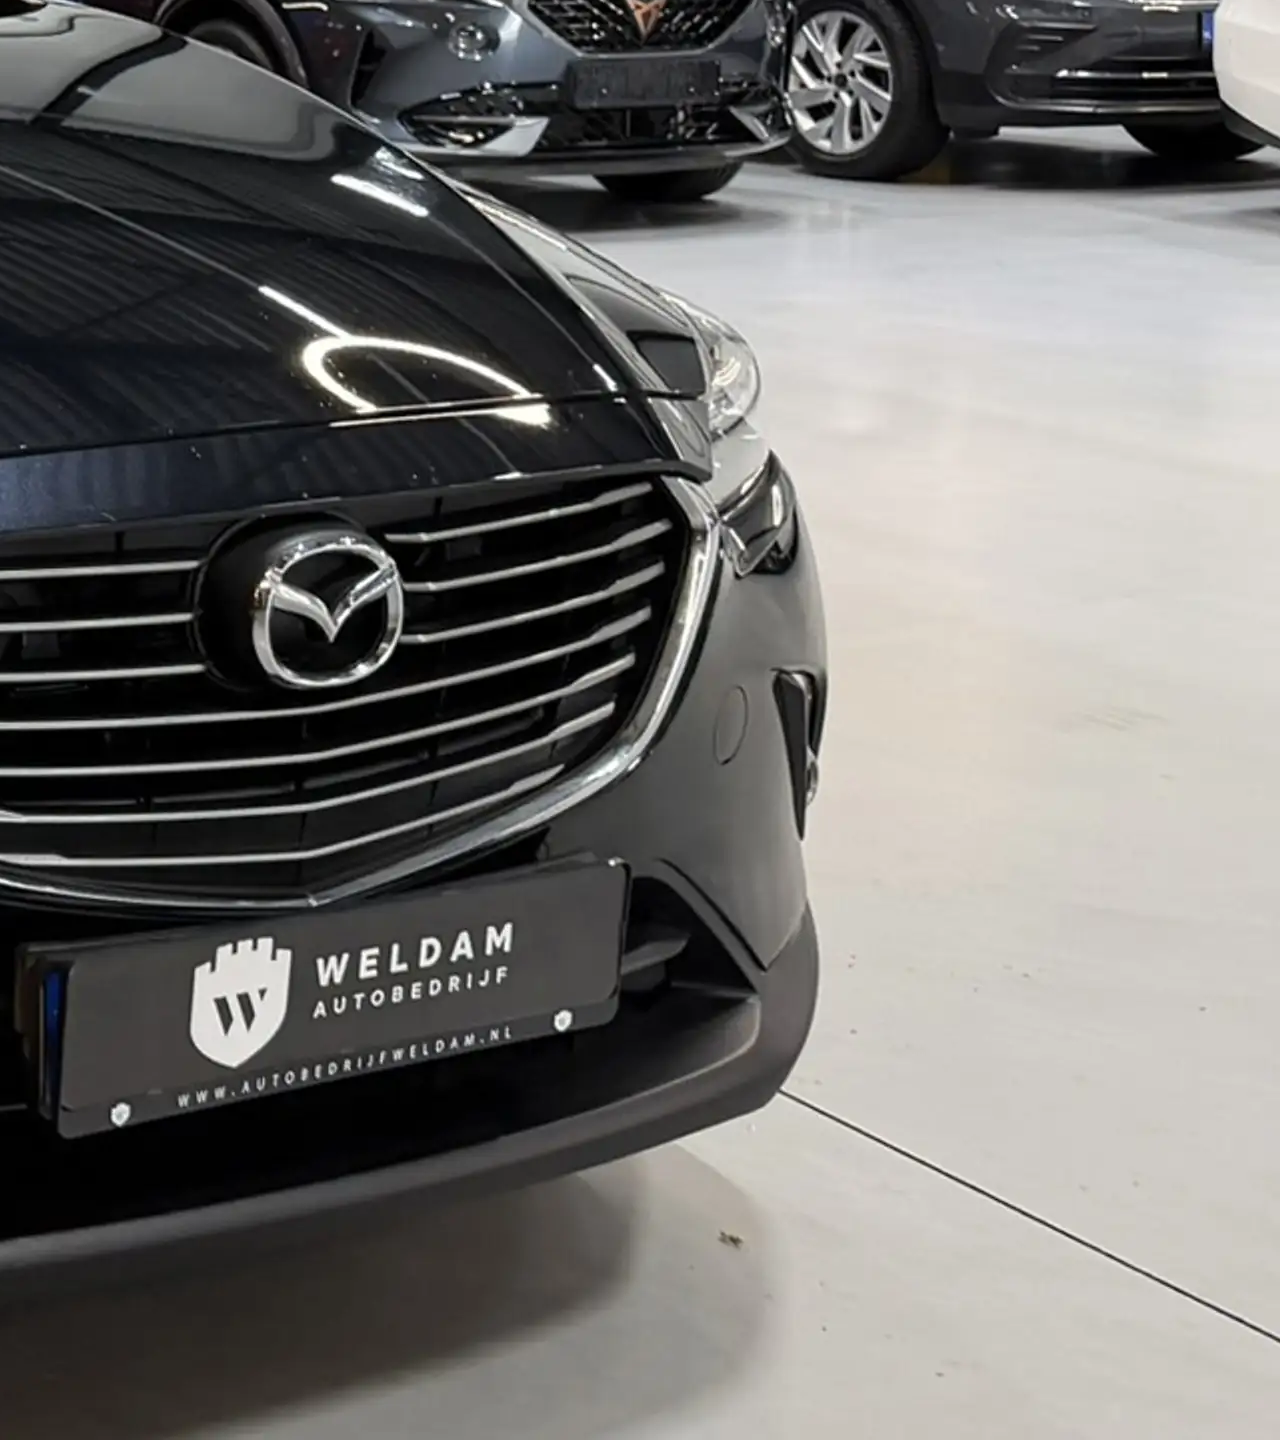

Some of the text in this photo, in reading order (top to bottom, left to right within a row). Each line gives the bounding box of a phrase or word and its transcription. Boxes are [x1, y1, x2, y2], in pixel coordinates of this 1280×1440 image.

[315, 921, 514, 988] WELDAM
[212, 986, 269, 1038] W
[312, 965, 510, 1020] AUTOBEDRIJF
[177, 1025, 513, 1109] WWW.AUTOBEDRIJFWELDAM.NL
